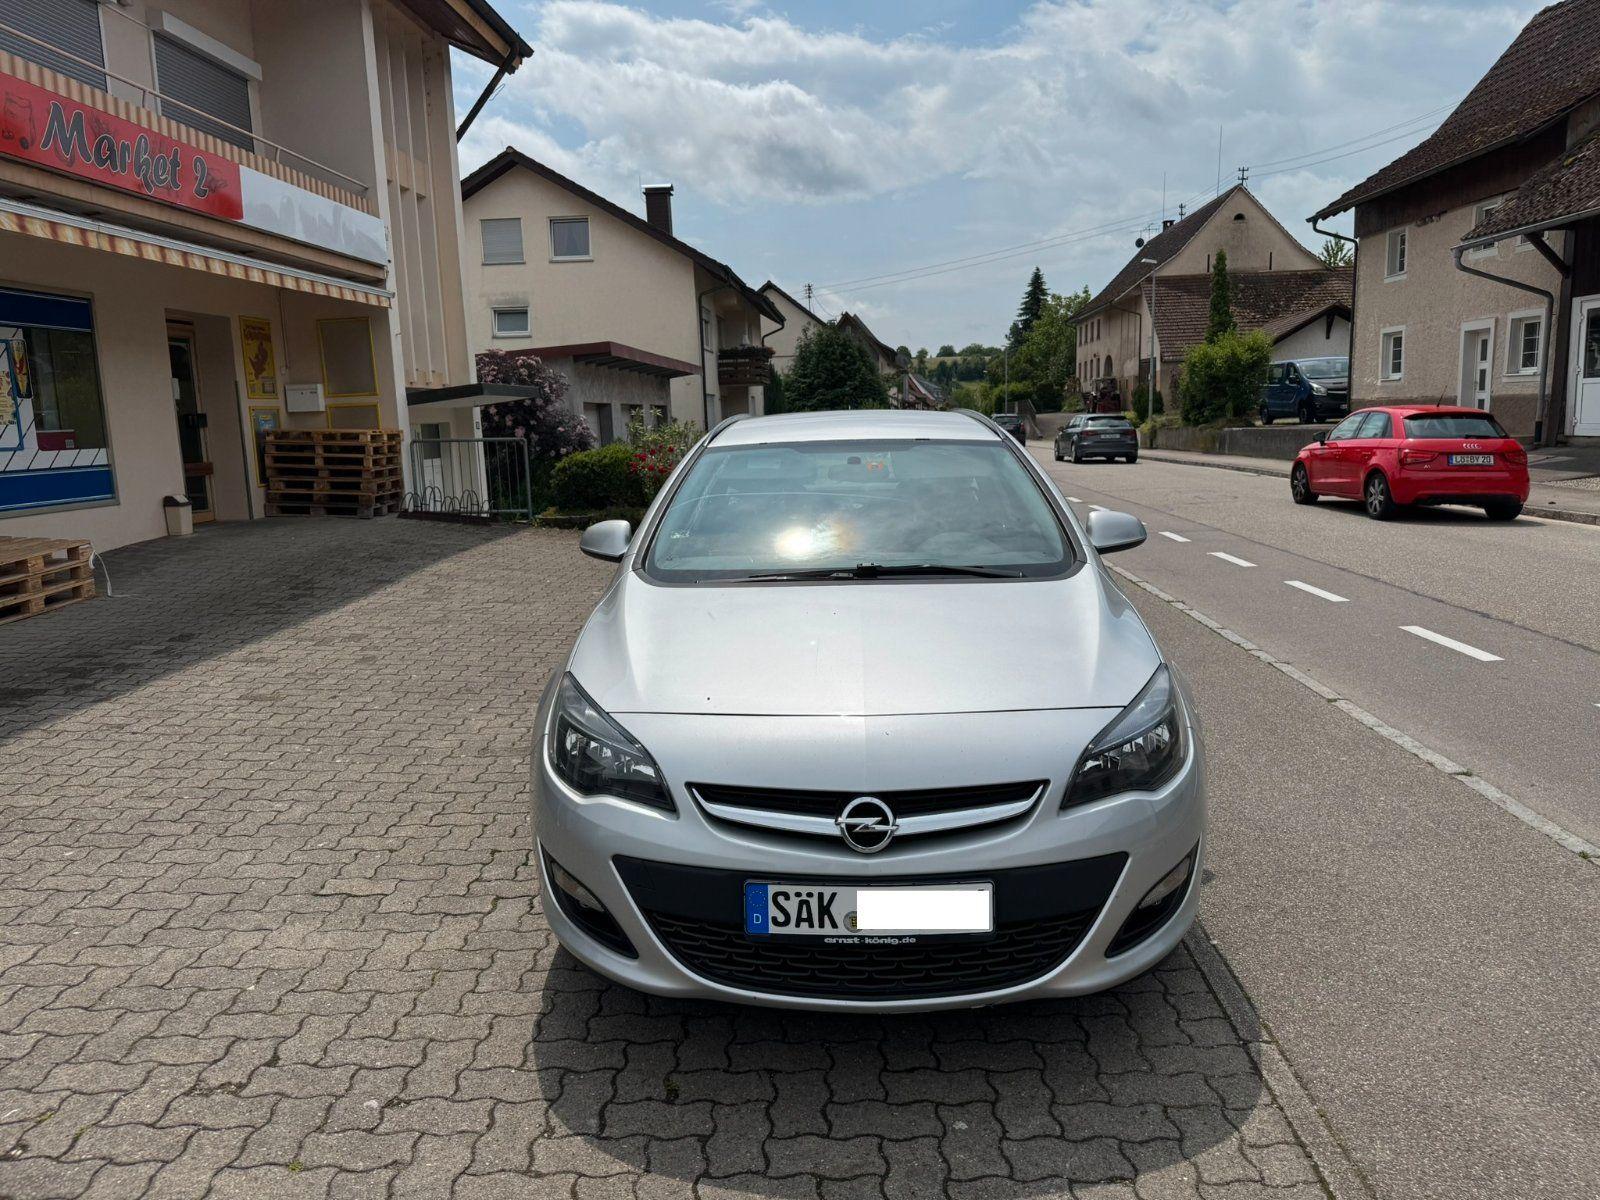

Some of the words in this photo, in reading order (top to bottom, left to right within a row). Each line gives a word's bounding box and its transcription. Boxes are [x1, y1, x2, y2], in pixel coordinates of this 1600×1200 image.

[40, 101, 181, 194] Market
[193, 155, 208, 199] 2
[753, 913, 762, 924] D
[771, 891, 838, 929] SÄK
